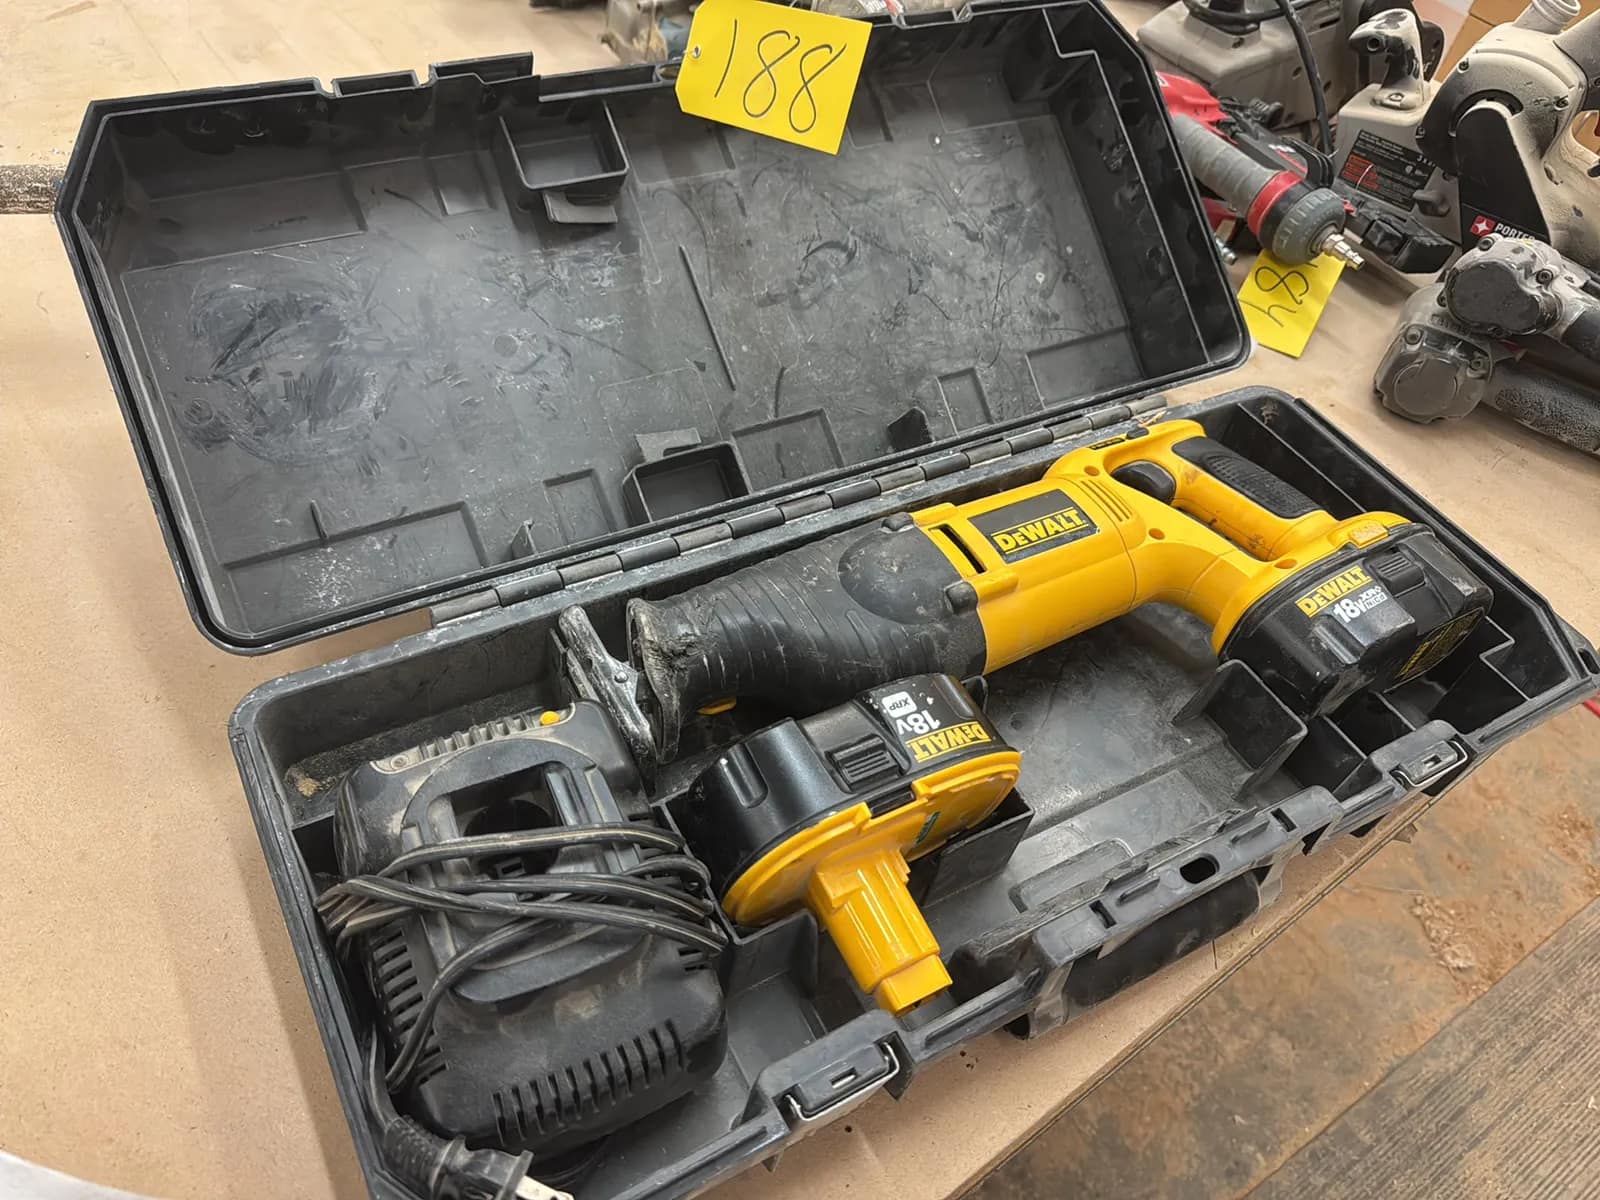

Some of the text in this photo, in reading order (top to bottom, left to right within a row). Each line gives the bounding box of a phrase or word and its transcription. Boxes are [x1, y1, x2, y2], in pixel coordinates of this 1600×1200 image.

[713, 18, 848, 134] 188
[993, 509, 1084, 552] DEWALT
[1296, 565, 1369, 614] DEWALT
[888, 697, 911, 711] XRP
[910, 723, 990, 759] DEWALT
